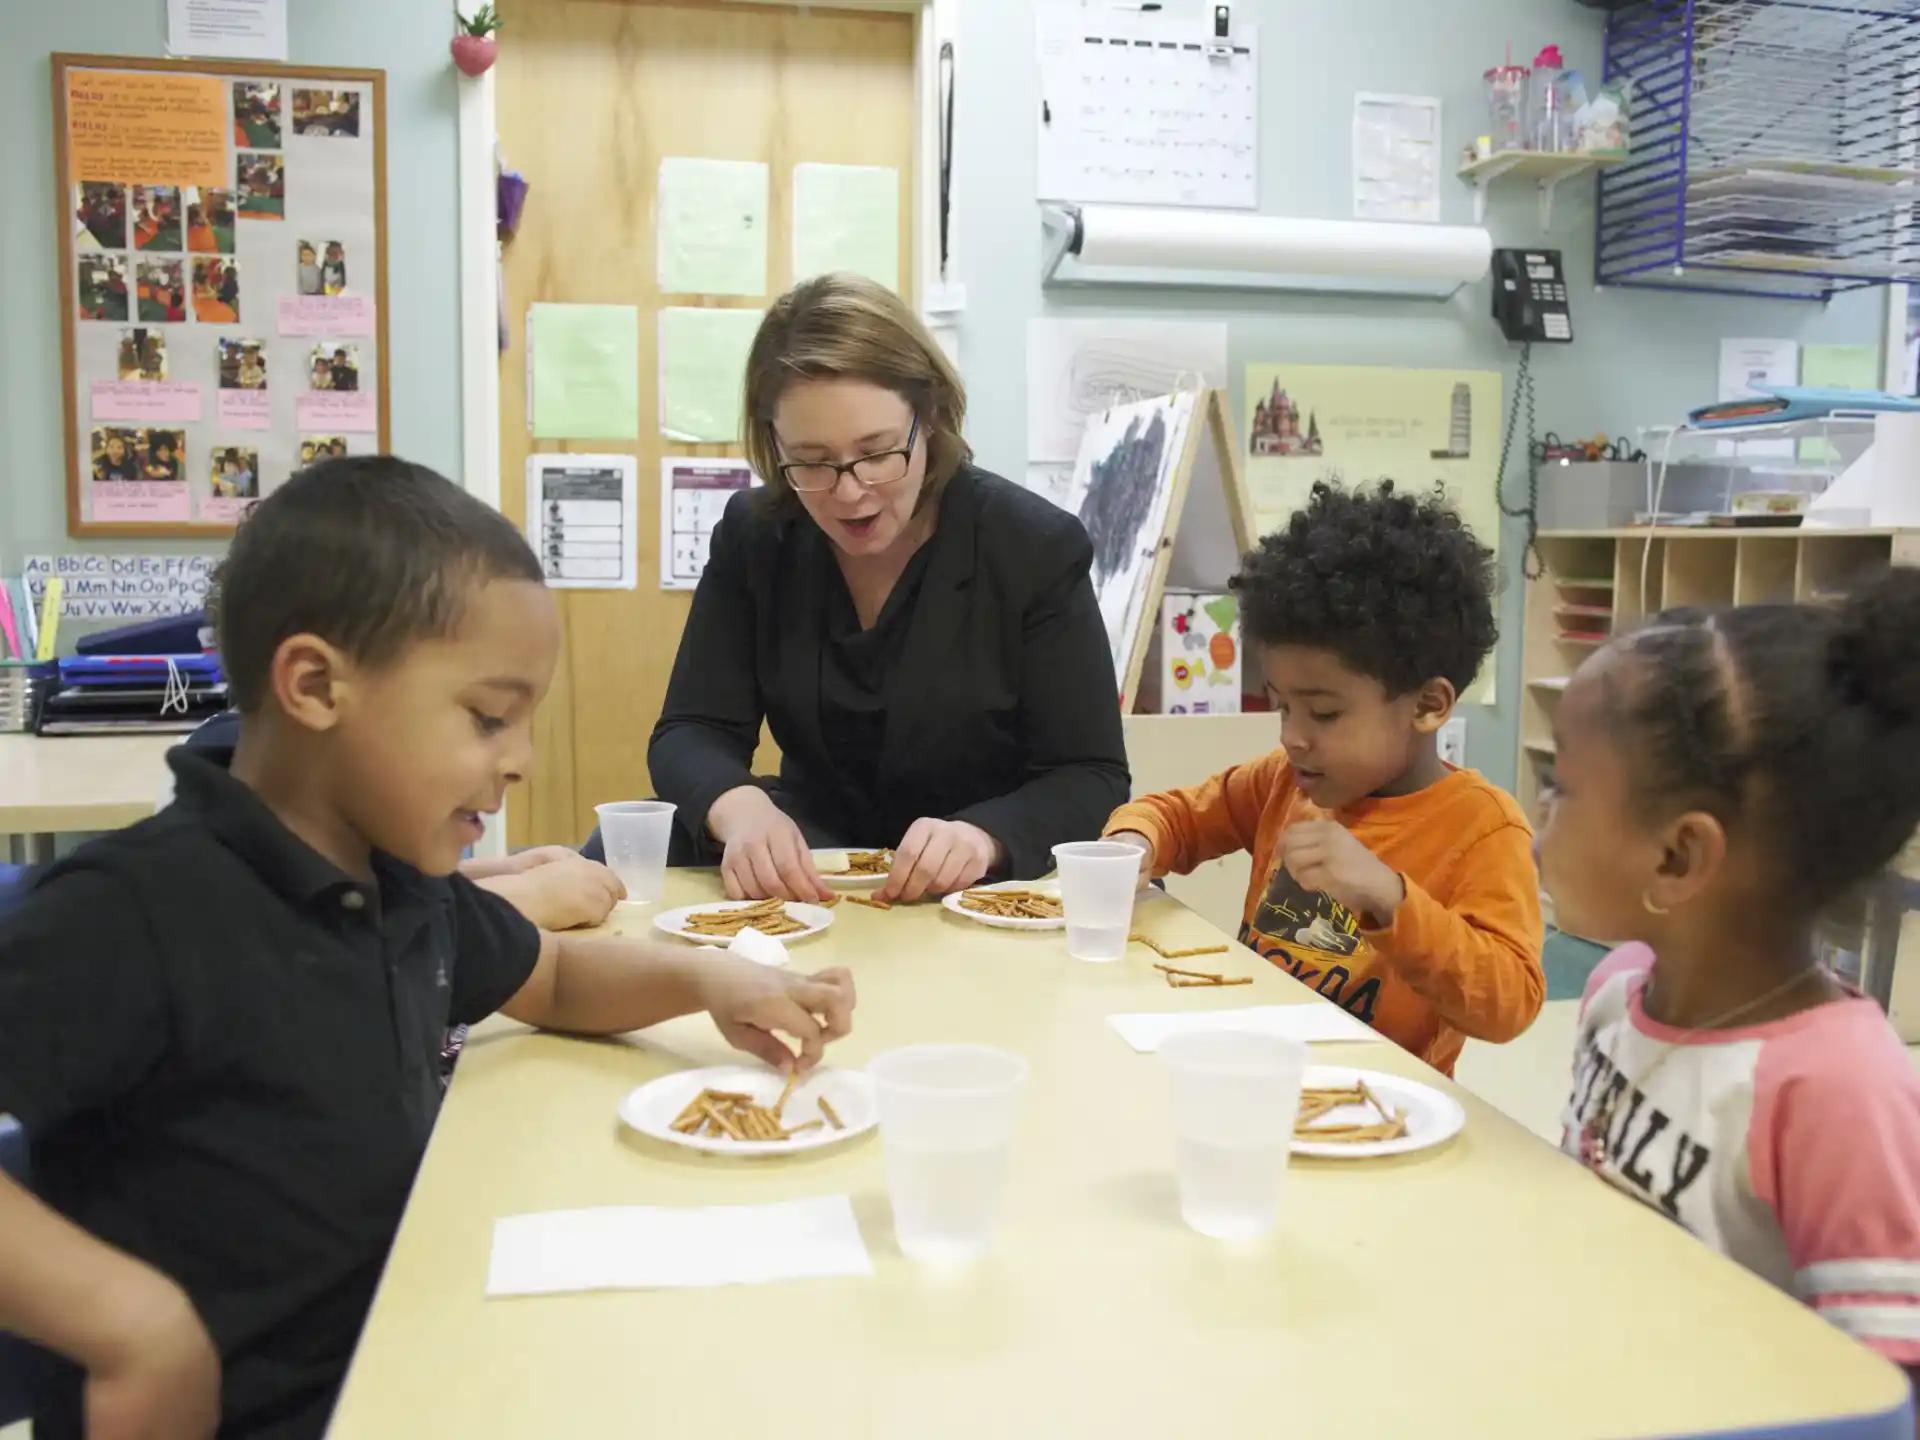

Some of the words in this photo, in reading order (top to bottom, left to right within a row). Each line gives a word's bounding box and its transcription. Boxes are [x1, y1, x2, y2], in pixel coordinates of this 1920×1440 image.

[27, 556, 50, 572] Aa
[57, 557, 80, 572] Bb
[84, 556, 105, 572] Cc
[112, 559, 135, 575] Dd
[165, 558, 186, 576] Ff
[77, 580, 108, 595] Mm
[112, 579, 136, 595] Nn
[140, 578, 164, 594] Oo
[169, 577, 188, 597] Pp
[84, 602, 106, 615] Vv
[111, 601, 142, 616] Ww
[148, 600, 171, 614] Xx
